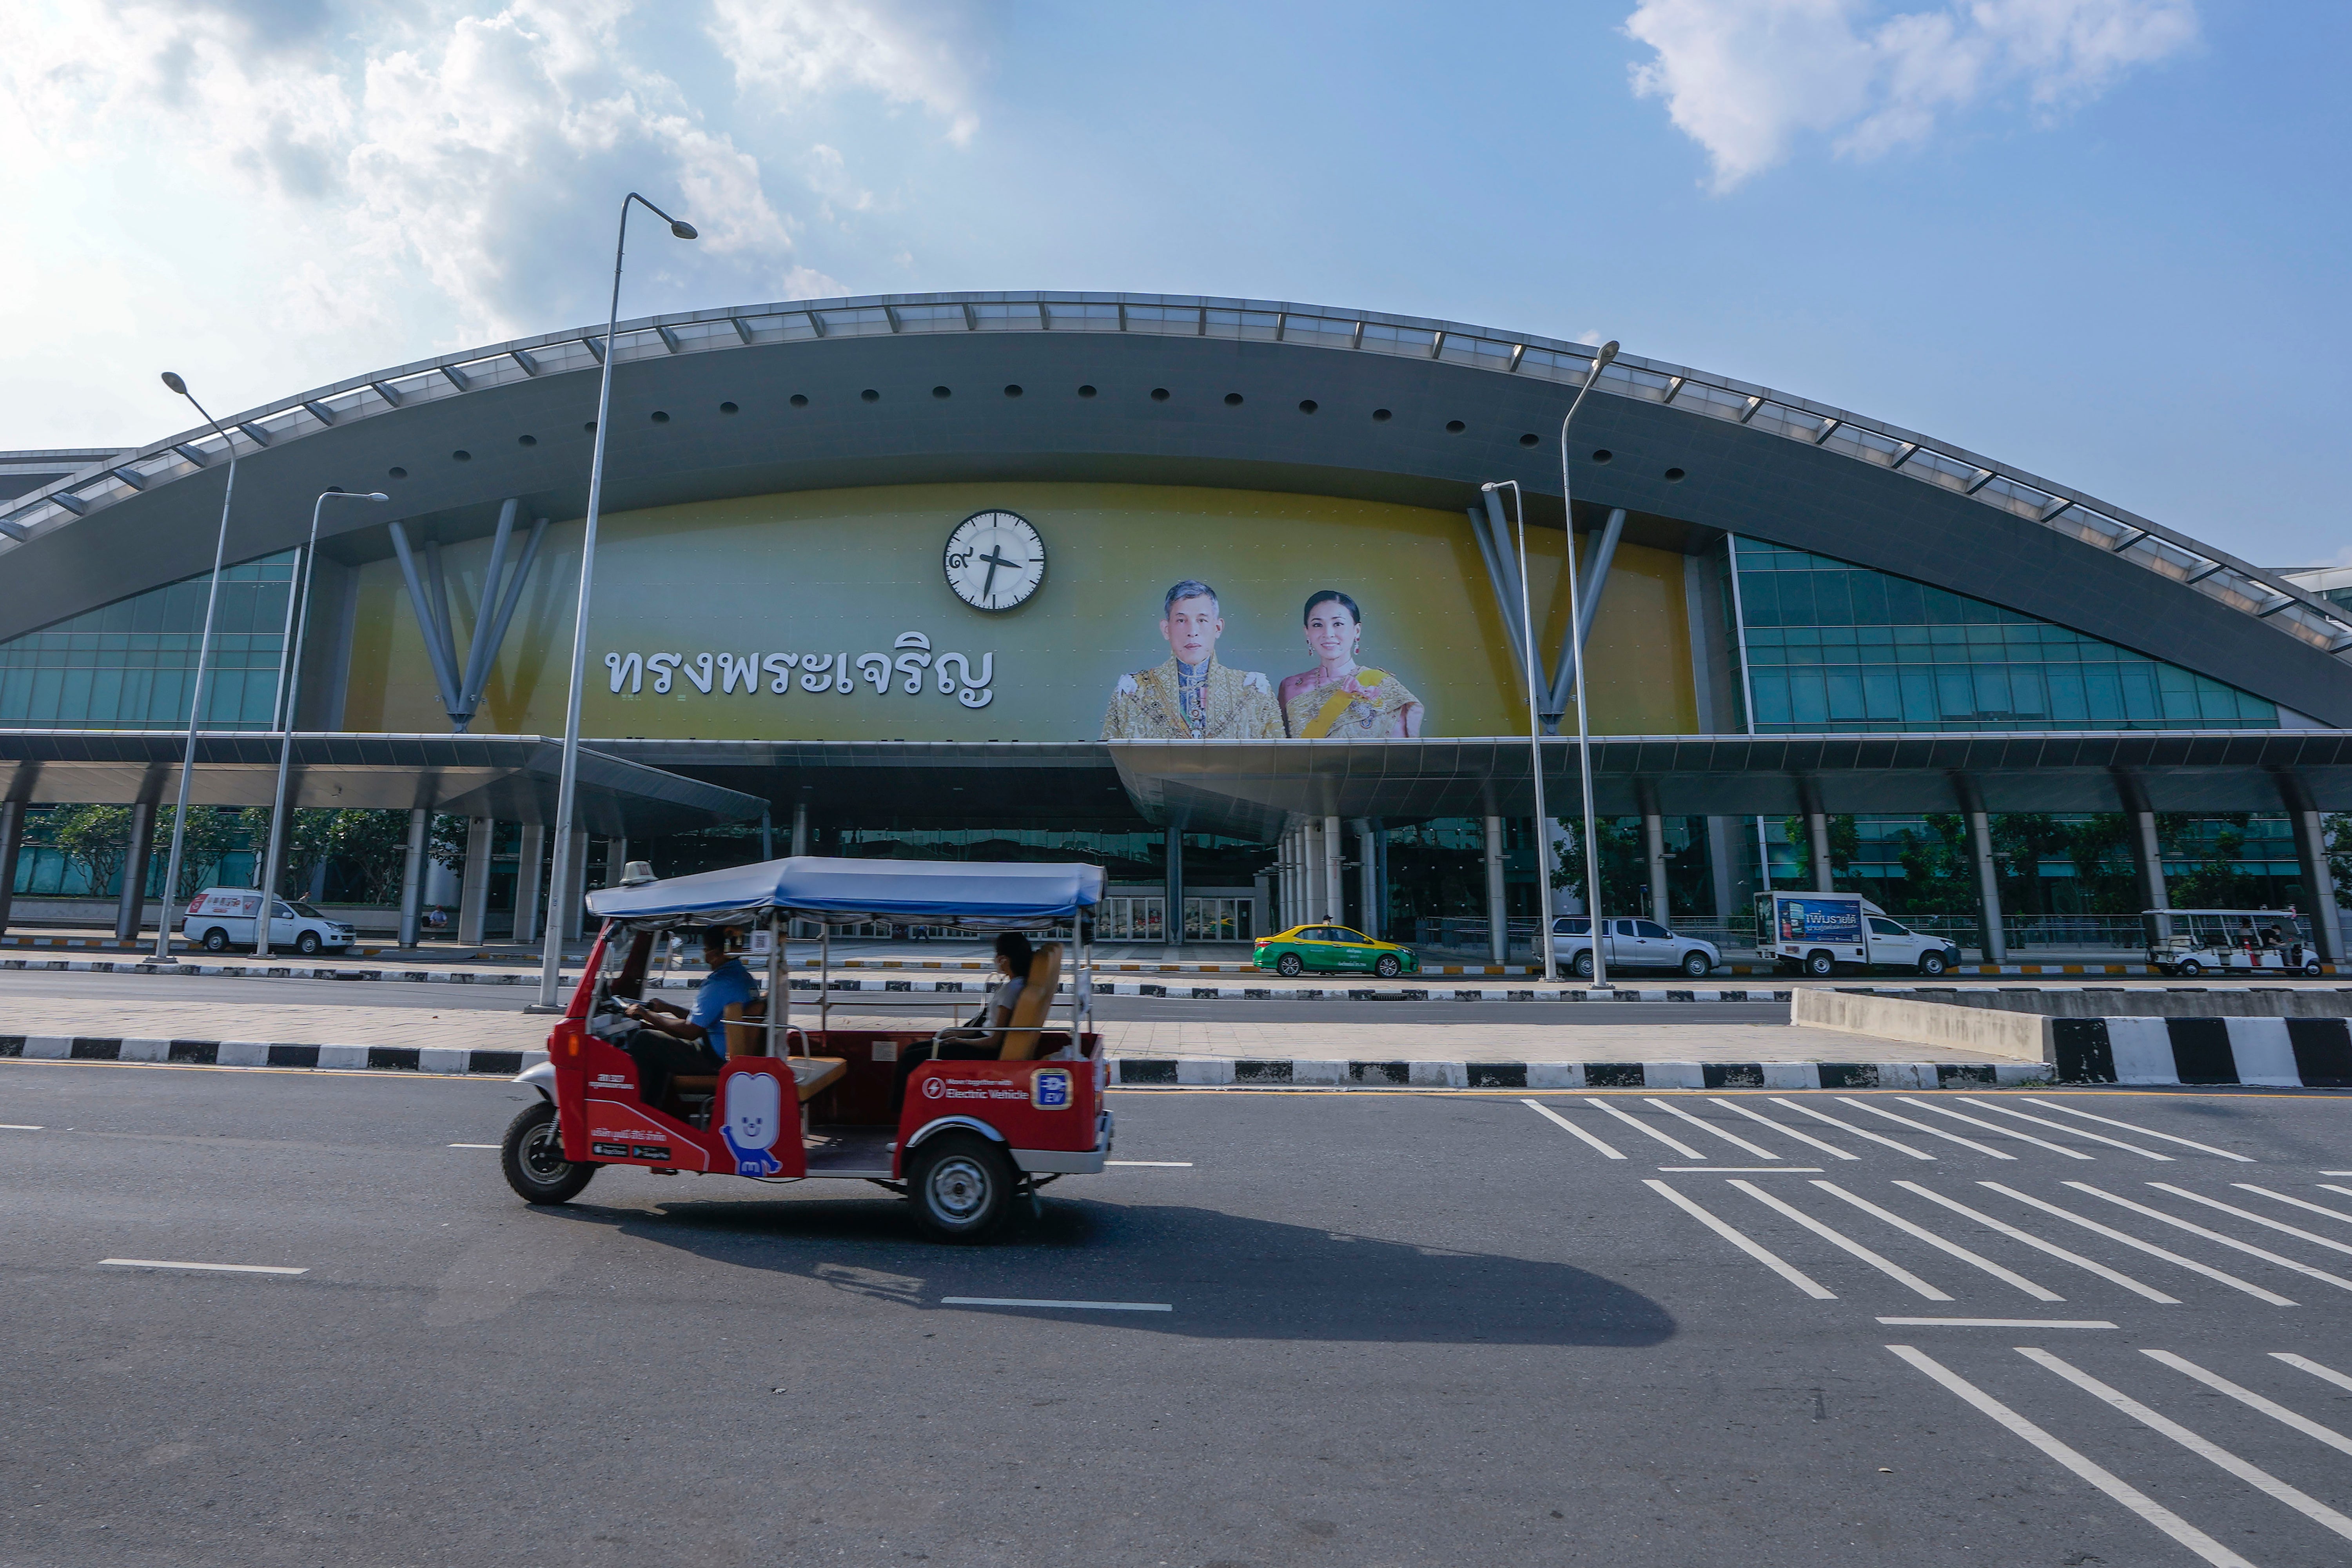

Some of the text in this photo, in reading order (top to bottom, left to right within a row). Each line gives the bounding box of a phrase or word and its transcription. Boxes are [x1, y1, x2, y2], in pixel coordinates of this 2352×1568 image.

[949, 546, 973, 568] ๙
[604, 631, 994, 709] ทรงพระเจริญ
[1806, 910, 1857, 924] เพิ่มรายได้
[946, 1088, 1029, 1099] Electric Vehicle
[1044, 1093, 1064, 1102] EV
